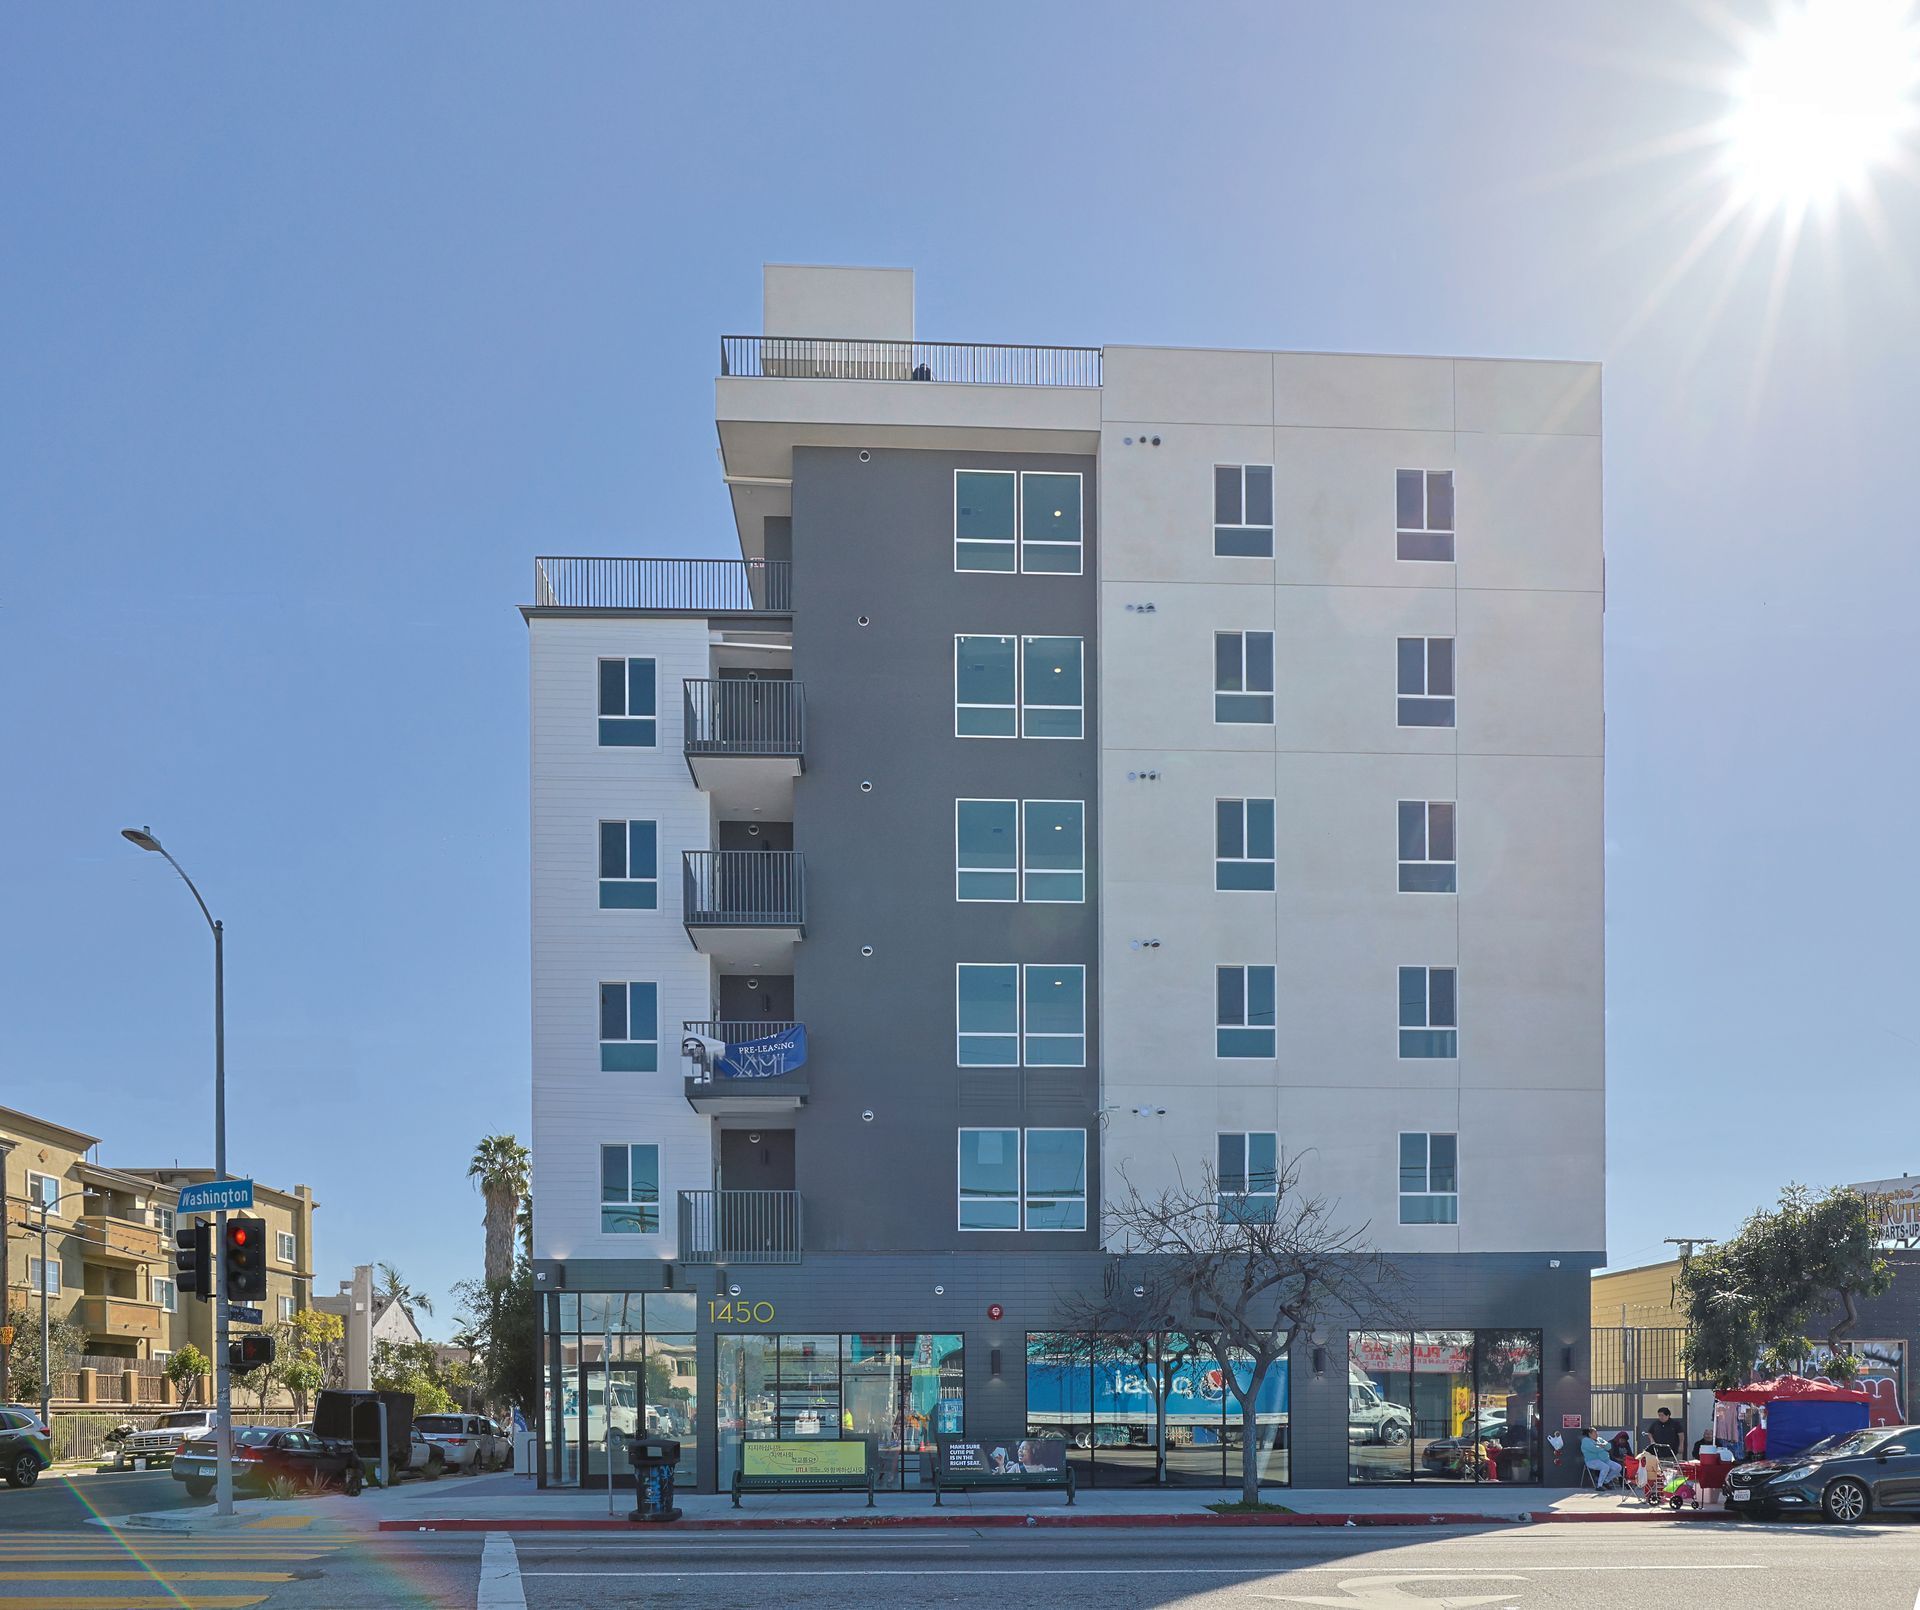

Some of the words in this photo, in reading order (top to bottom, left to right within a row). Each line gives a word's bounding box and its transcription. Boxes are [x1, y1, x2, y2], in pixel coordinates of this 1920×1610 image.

[738, 1042, 794, 1054] PRE-LEASING
[182, 1188, 248, 1208] Washington
[707, 1301, 775, 1323] 1450
